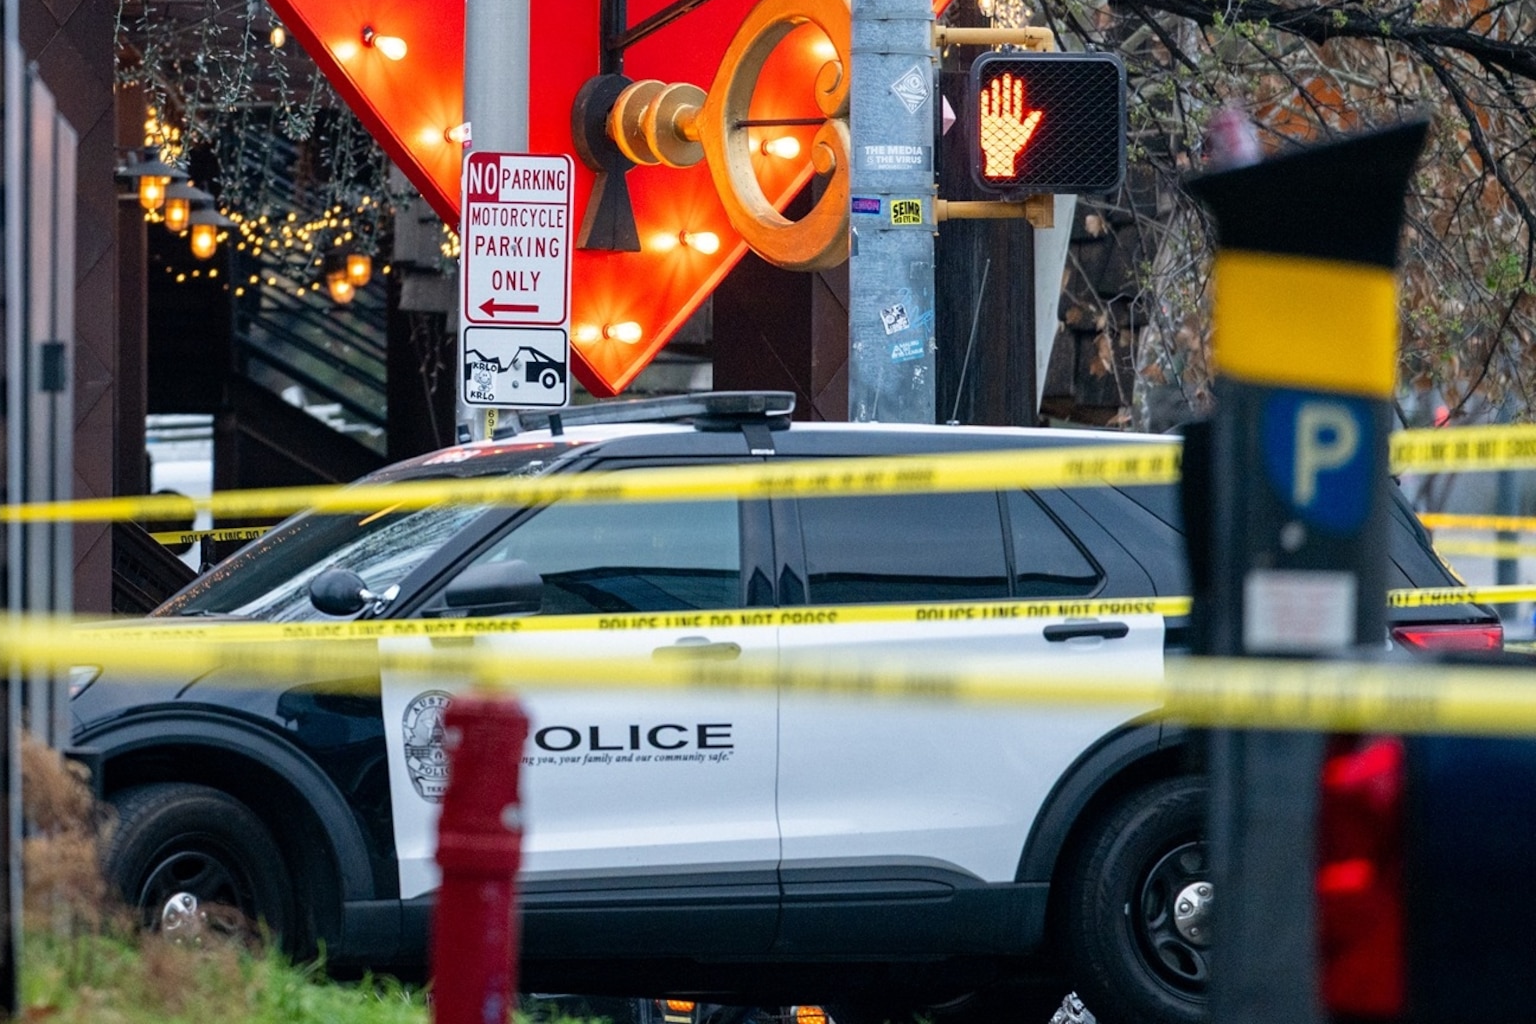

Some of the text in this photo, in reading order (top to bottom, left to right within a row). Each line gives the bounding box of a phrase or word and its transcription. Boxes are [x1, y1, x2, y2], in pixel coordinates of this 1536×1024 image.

[865, 145, 923, 155] THE MEDIA
[876, 156, 894, 164] THE
[896, 156, 922, 164] VIRUS
[469, 162, 565, 195] NO PARKING
[472, 207, 564, 228] MOTORCYCLE
[475, 236, 559, 257] PARKING
[492, 270, 541, 291] ONLY
[472, 362, 498, 372] KRLO
[470, 391, 495, 401] KRLO
[1293, 400, 1360, 507] P
[413, 698, 450, 715] AUSTI
[534, 723, 734, 752] OLICE
[537, 755, 557, 765] you,
[559, 755, 581, 765] your
[582, 753, 613, 765] family
[615, 754, 634, 763] and
[635, 754, 652, 763] our
[654, 753, 706, 764] community
[418, 764, 450, 776] POLIC
